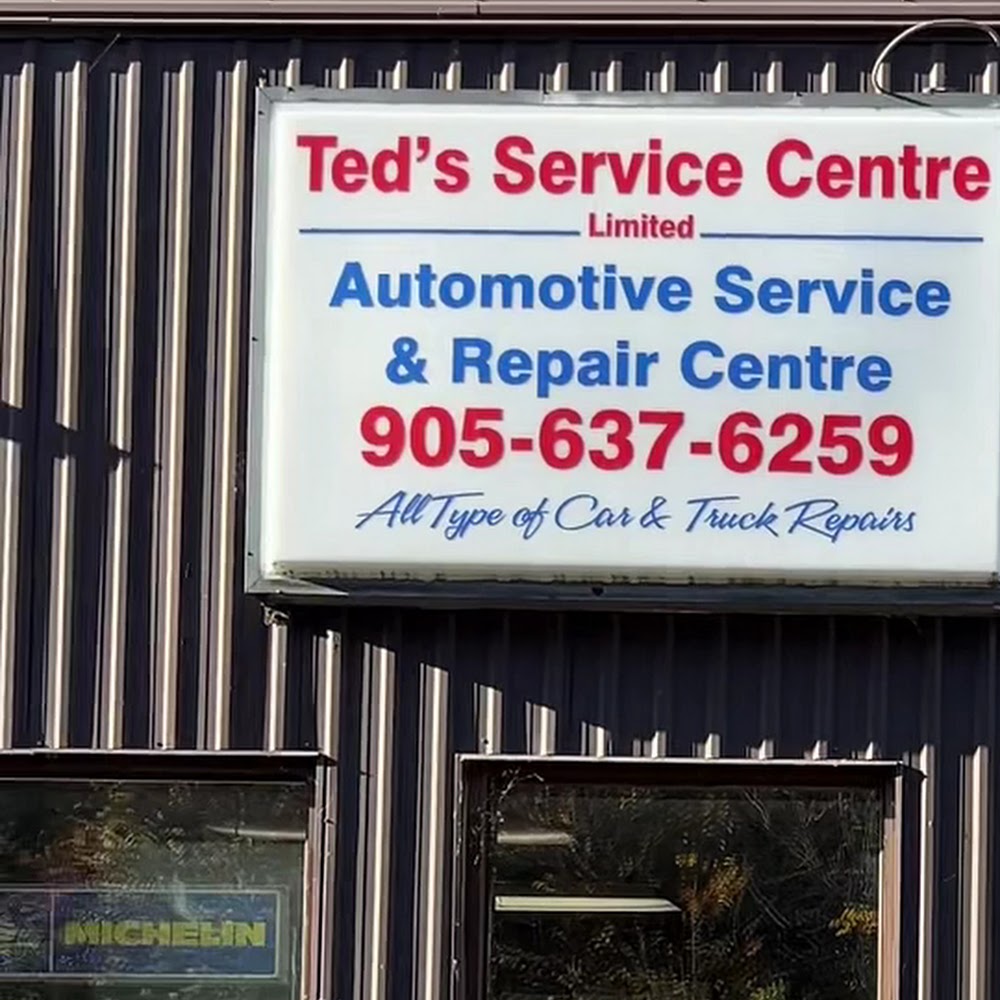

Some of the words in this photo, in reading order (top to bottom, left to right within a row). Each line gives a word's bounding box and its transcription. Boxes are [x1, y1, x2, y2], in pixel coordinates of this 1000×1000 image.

[297, 135, 470, 195] Ted's
[494, 136, 744, 198] Service
[766, 139, 991, 201] Centre
[588, 213, 695, 239] Limited
[330, 262, 692, 313] Automotive
[715, 266, 951, 318] Service
[386, 338, 427, 385] &
[452, 338, 659, 398] Repair
[680, 341, 893, 394] Centre
[359, 405, 914, 477] 905-637-6259
[355, 490, 427, 529] All
[428, 492, 506, 540] Type
[511, 497, 550, 540] of
[553, 494, 635, 531] Car
[640, 495, 672, 530] &
[685, 496, 780, 537] Truck
[784, 499, 917, 543] Repairs
[64, 920, 266, 947] MICHELIN
